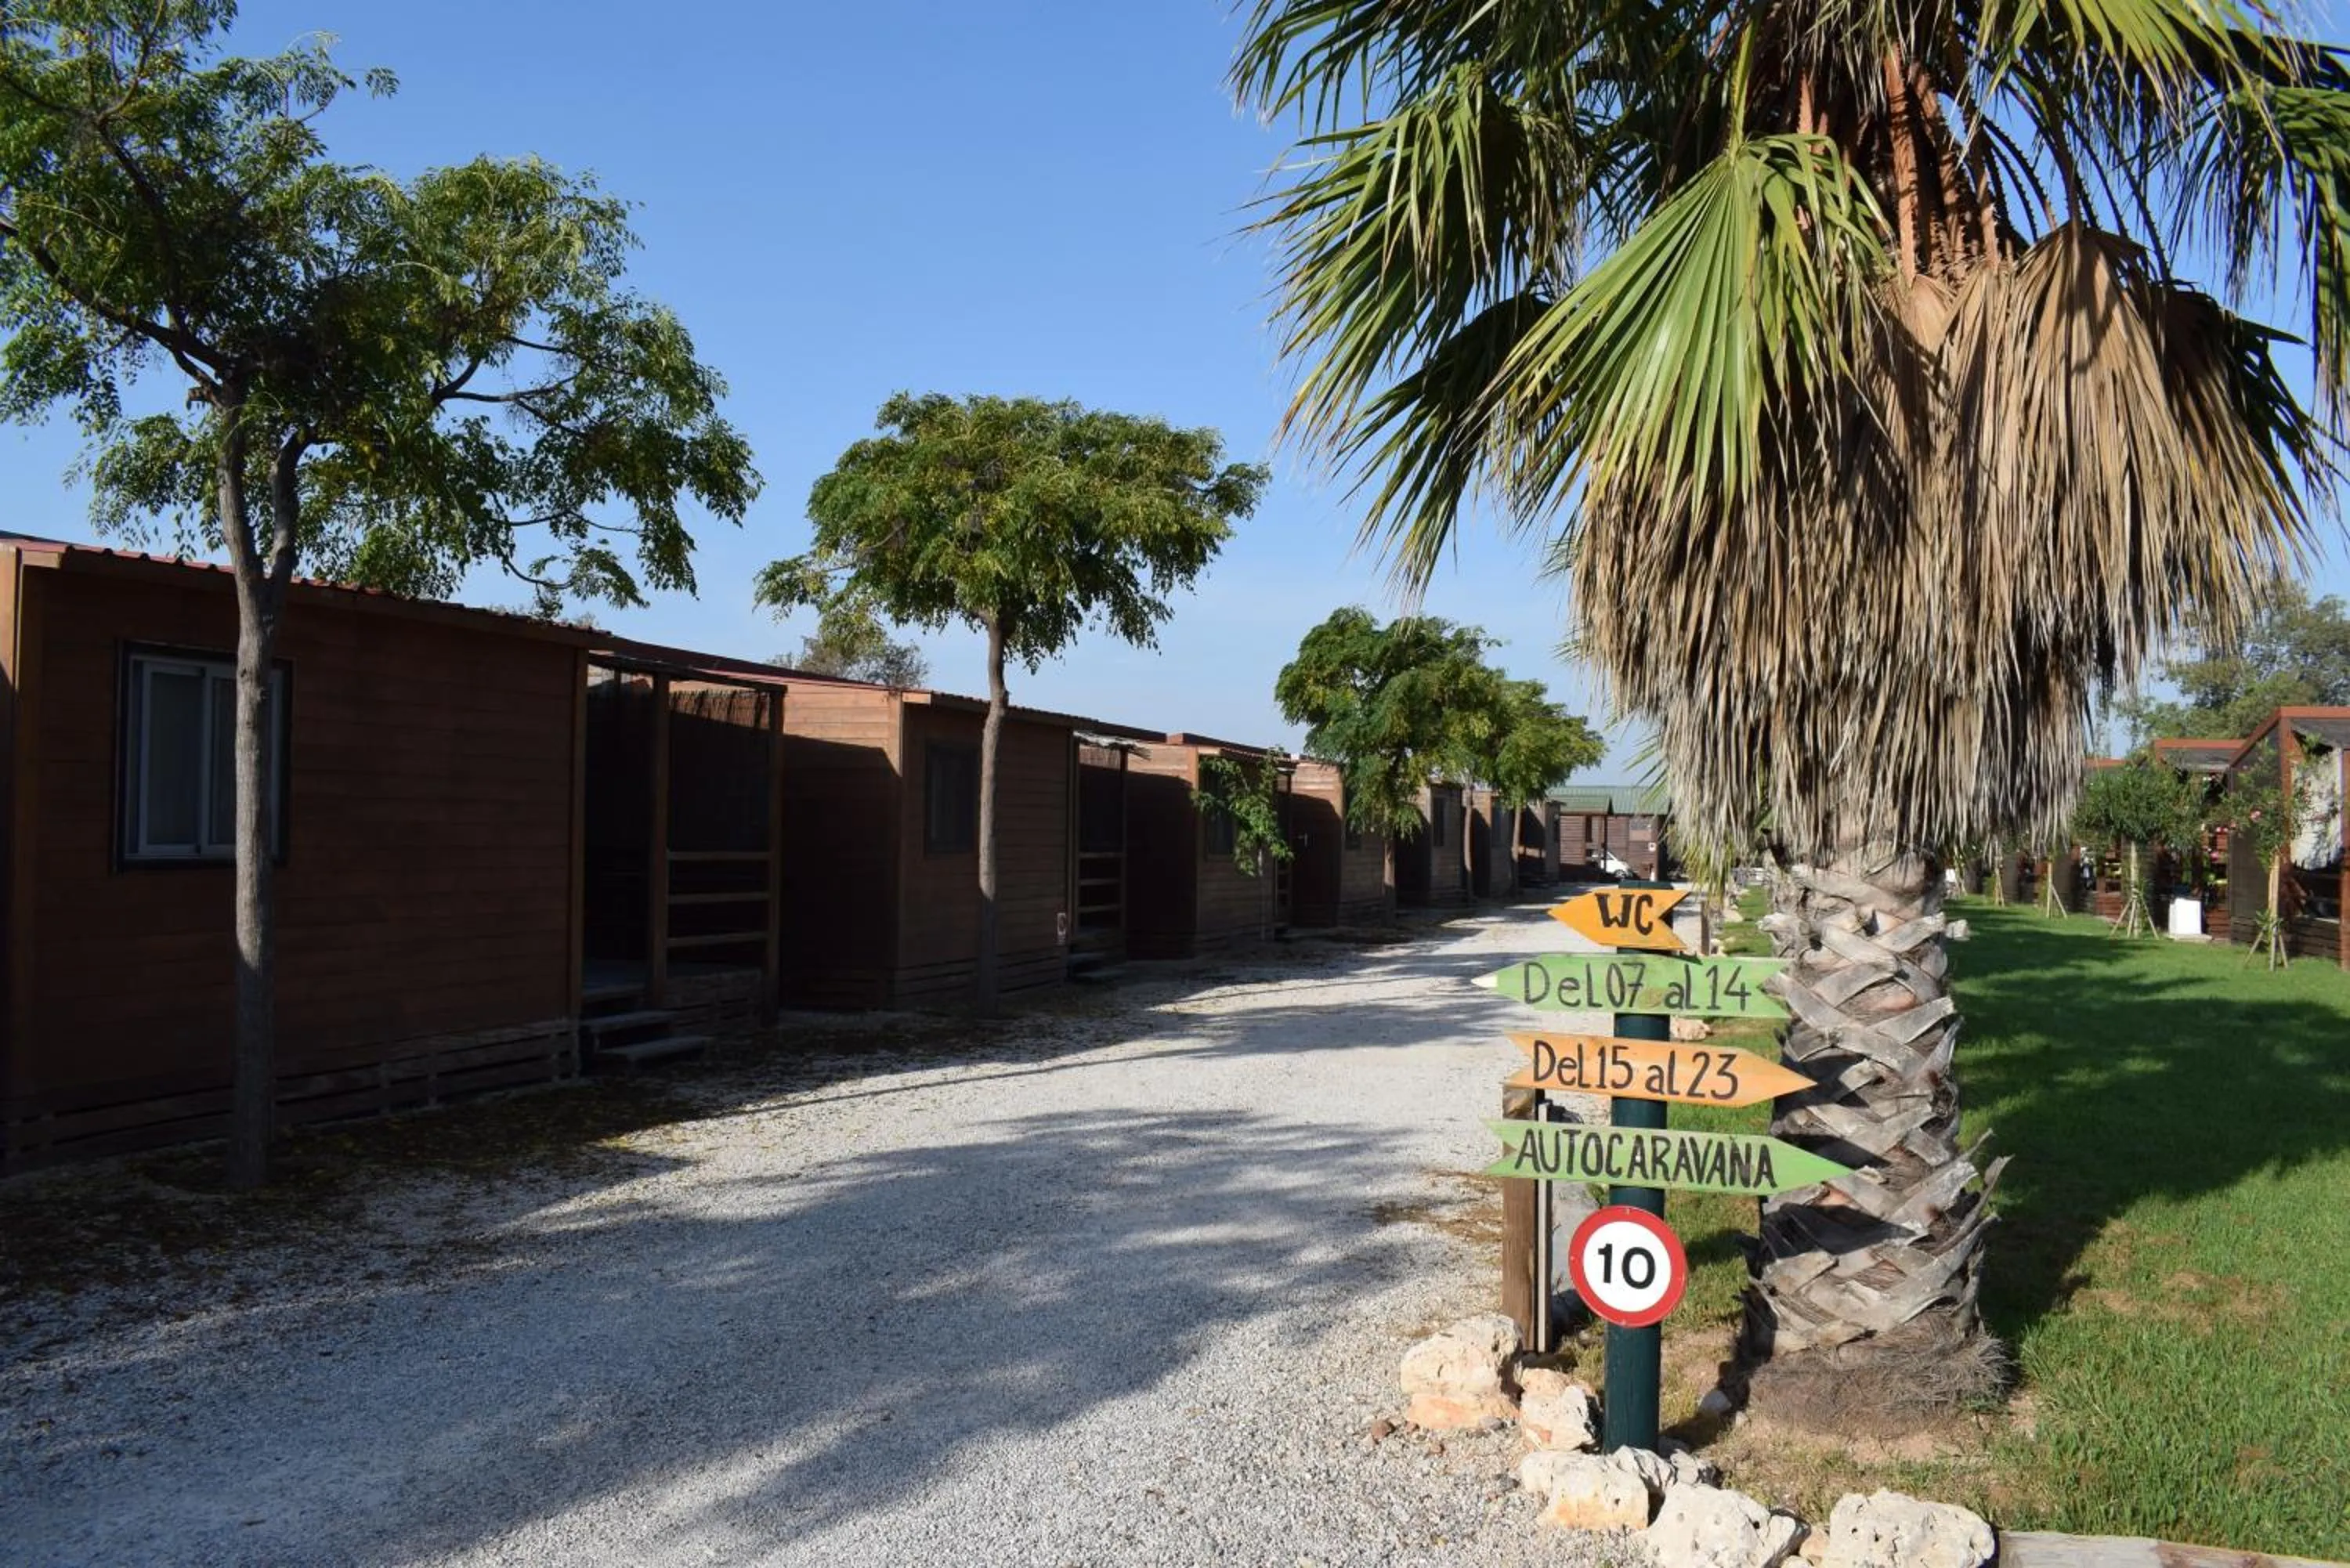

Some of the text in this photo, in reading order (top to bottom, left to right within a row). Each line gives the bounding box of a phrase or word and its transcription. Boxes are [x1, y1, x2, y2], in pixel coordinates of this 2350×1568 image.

[1595, 893, 1654, 936] WC
[1705, 964, 1752, 1011] 14
[1687, 1050, 1739, 1100] 23
[1515, 1129, 1779, 1188] AUTOCARAVANA
[1598, 1243, 1656, 1290] 10
